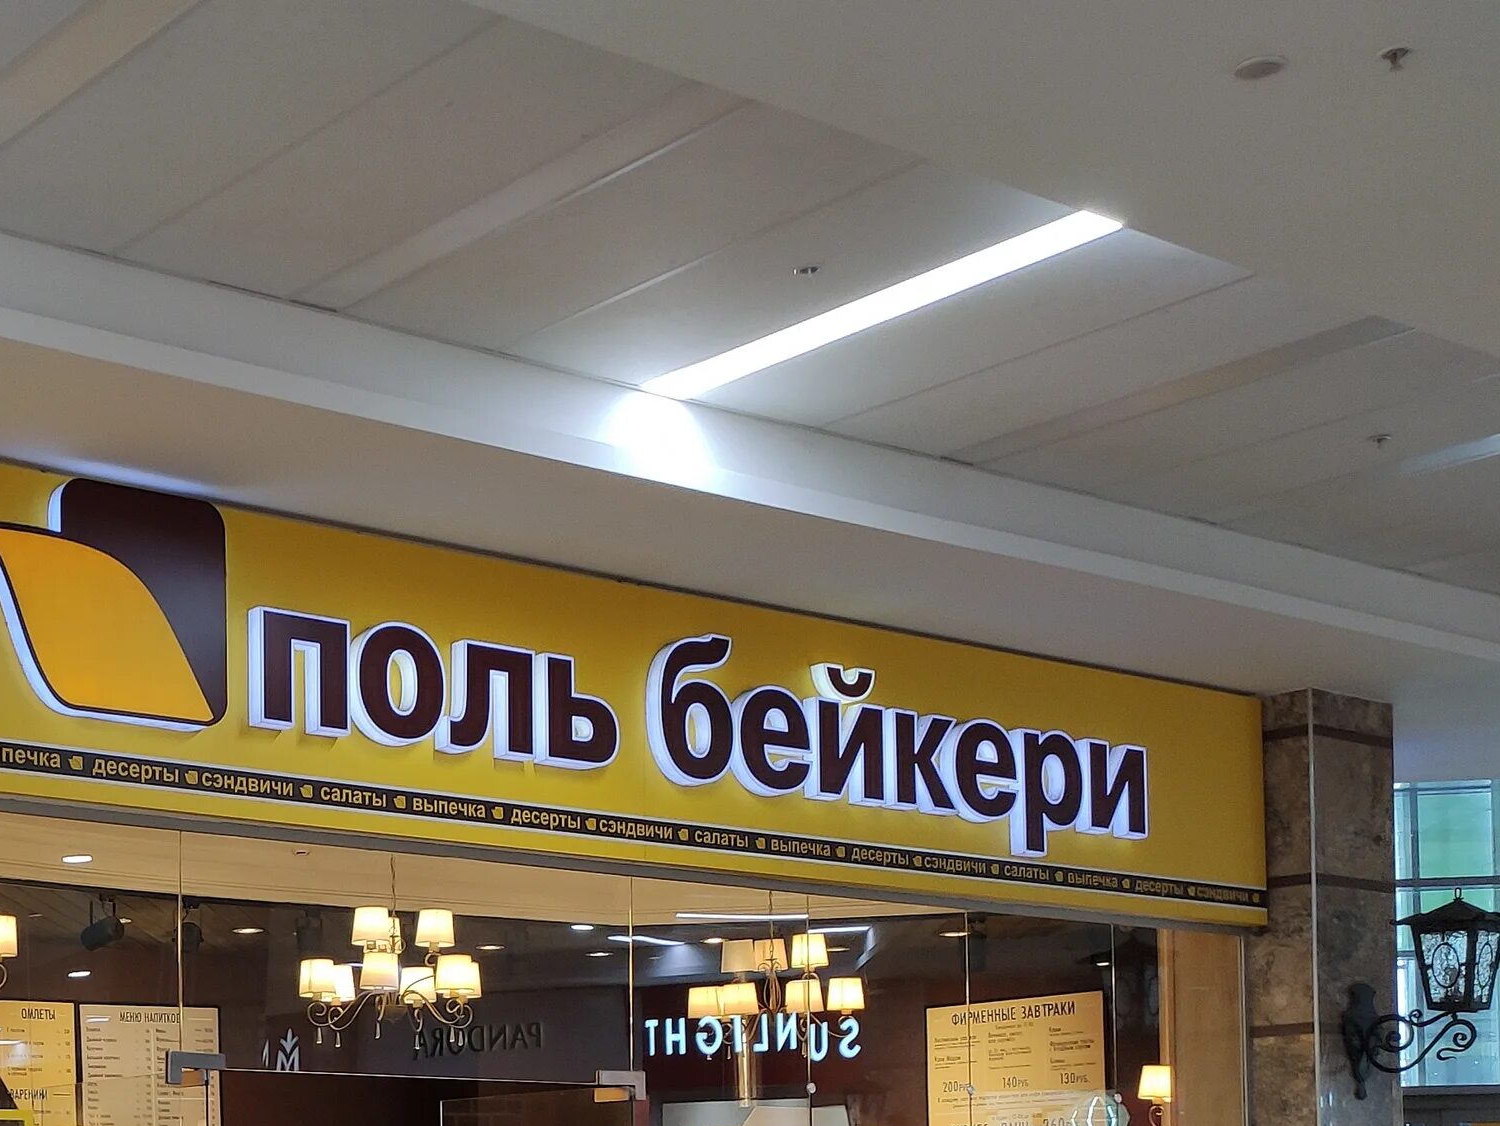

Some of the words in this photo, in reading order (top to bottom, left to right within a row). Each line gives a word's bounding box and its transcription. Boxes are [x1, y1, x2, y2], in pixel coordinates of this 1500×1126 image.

[248, 605, 620, 770] поль
[646, 633, 1149, 857] бейкери
[92, 758, 179, 783] десерты
[201, 771, 293, 797] сэндвичи
[320, 786, 387, 808] салаты
[413, 797, 486, 819] выпечка
[510, 809, 581, 831] десерты
[599, 819, 673, 840] сэндвичи
[694, 830, 749, 848] салаты
[771, 839, 831, 857] выпечка
[851, 847, 909, 866] десерты
[923, 855, 986, 875] сэндвичи
[1004, 864, 1049, 881] салаты
[1068, 872, 1119, 889] выпечка
[1135, 879, 1183, 897] десерты
[21, 1008, 56, 1020] ОМЛЕТЫ
[120, 1011, 142, 1023] МЕНЮ
[951, 1007, 1016, 1026] ФИРМЕННЫЕ
[1021, 1001, 1075, 1020] ЗАВТРАКИ
